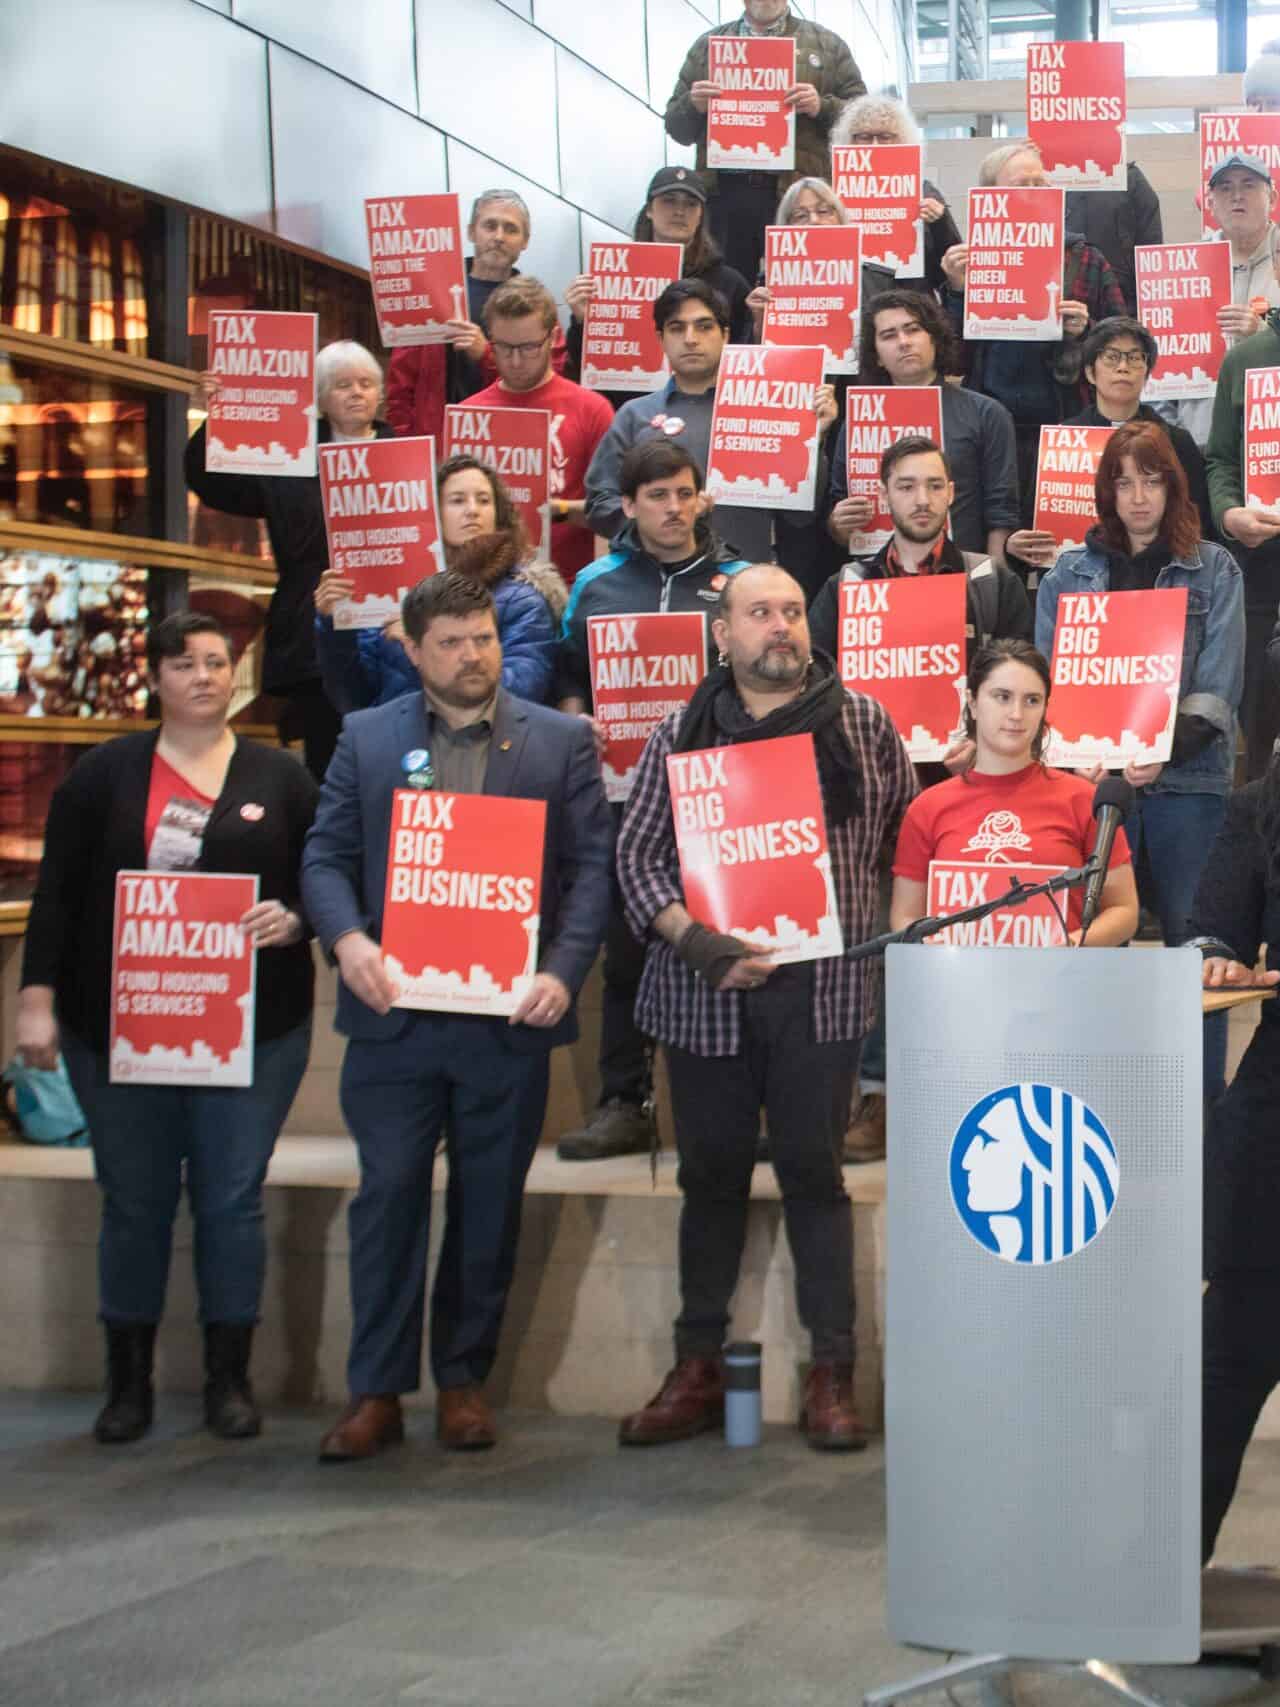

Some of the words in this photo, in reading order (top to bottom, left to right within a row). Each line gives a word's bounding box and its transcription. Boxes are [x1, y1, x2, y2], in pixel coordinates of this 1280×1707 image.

[712, 41, 747, 64] TAX
[1030, 45, 1065, 68] TAX
[713, 68, 788, 90] AMAZON
[1030, 72, 1060, 95] BIG
[720, 114, 766, 126] SERVICES
[1030, 98, 1121, 121] BUSINESS
[1203, 118, 1240, 141] TAX
[835, 150, 872, 172] TAX
[837, 175, 916, 198] AMAZON
[368, 202, 406, 228] TAX
[972, 194, 1008, 218] TAX
[861, 222, 893, 234] VICES
[971, 223, 1054, 247] AMAZON
[372, 228, 453, 256] AMAZON
[769, 232, 808, 256] TAX
[374, 260, 402, 274] FUND
[404, 257, 426, 272] THE
[592, 248, 629, 272] TAX
[970, 251, 999, 265] FUND
[1002, 252, 1024, 265] THE
[1139, 251, 1162, 272] NO
[1166, 248, 1198, 271] TAX
[769, 260, 854, 286] AMAZON
[970, 270, 1006, 284] GREEN
[376, 278, 411, 293] GREEN
[969, 289, 995, 303] NEW
[997, 289, 1026, 303] DEAL
[1141, 276, 1211, 300] SHELTER
[378, 296, 403, 311] NEW
[406, 295, 432, 309] DEAL
[589, 304, 617, 318] FUND
[621, 305, 641, 319] THE
[799, 297, 844, 310] HOUSING
[588, 322, 624, 336] GREEN
[778, 313, 828, 327] SERVICES
[1142, 307, 1173, 328] FOR
[214, 317, 256, 344] TAX
[587, 341, 611, 354] NEW
[614, 342, 640, 355] DEAL
[1154, 333, 1211, 356] MAZON
[212, 348, 308, 377] AMAZON
[727, 350, 767, 375] TAX
[216, 388, 243, 402] UND
[719, 379, 815, 410] AMAZON
[851, 394, 886, 422] TAX
[448, 411, 492, 440] TAX
[716, 418, 746, 432] FUND
[749, 419, 800, 436] HOUSING
[725, 436, 781, 453] SERVICES
[1044, 429, 1088, 448] TAX
[1250, 441, 1279, 458] FUND
[323, 448, 370, 481] TAX
[851, 458, 877, 474] FUND
[1043, 449, 1103, 474] AMA
[329, 480, 428, 517] AMAZON
[851, 479, 882, 495] GREE
[1041, 481, 1072, 496] FUND
[1040, 497, 1048, 512] &
[1050, 499, 1098, 516] SERVIC
[333, 530, 365, 548] FUND
[367, 526, 420, 545] HOUSING
[346, 548, 404, 567] SERVICES
[843, 583, 890, 614] TAX
[1063, 595, 1109, 624] TAX
[592, 621, 639, 653] TAX
[843, 615, 882, 647] BIG
[1058, 627, 1099, 654] BIG
[596, 654, 697, 689] AMAZON
[842, 643, 960, 681] BUSINESS
[1055, 655, 1175, 685] BUSINESS
[598, 702, 627, 721] FUND
[609, 720, 658, 741] SERVIC
[673, 751, 728, 792] TAX
[399, 794, 455, 830] TAX
[678, 792, 725, 832] BIG
[394, 829, 443, 866] BIG
[684, 817, 819, 869] USINESS
[122, 879, 179, 915] TAX
[391, 867, 534, 912] BUSINESS
[935, 871, 988, 906] TAX
[119, 920, 244, 959] AMAZON
[118, 971, 159, 992] FUND
[162, 972, 229, 994] HOUSING
[132, 994, 205, 1016] SERVICES
